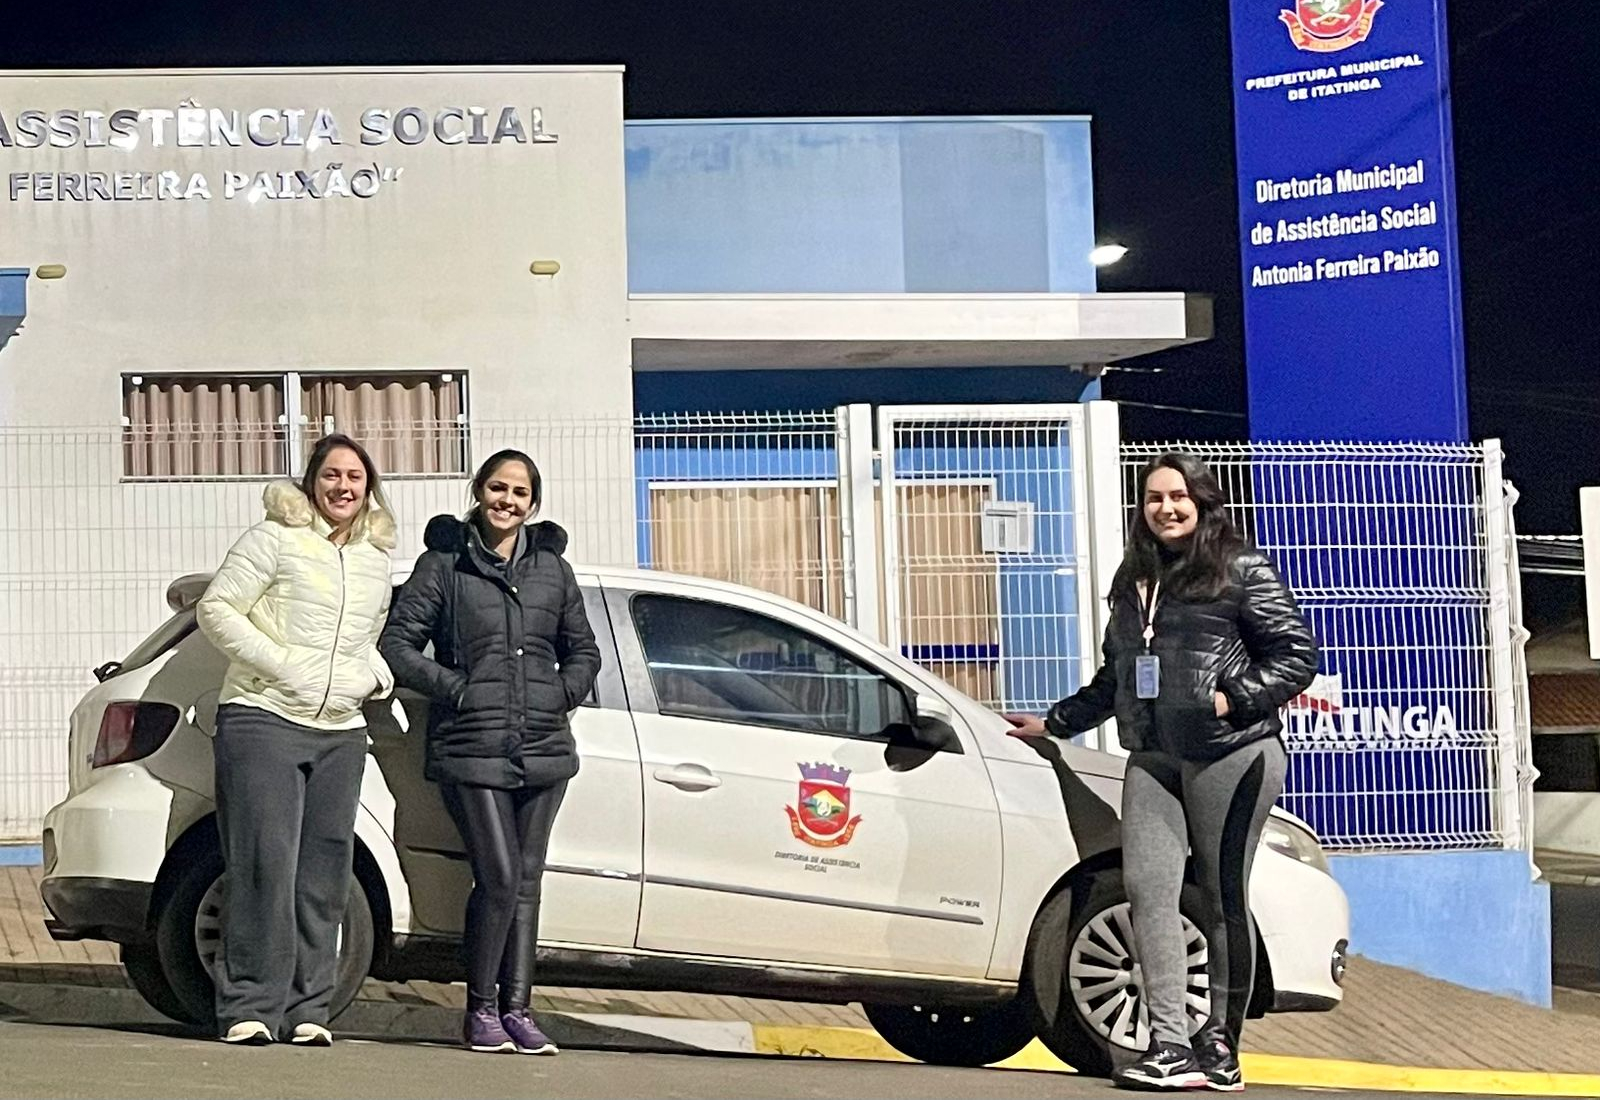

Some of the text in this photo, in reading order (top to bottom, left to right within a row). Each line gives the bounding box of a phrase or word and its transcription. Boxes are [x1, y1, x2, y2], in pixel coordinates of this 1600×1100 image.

[1246, 54, 1423, 90] PREFEITURA MUNICIPAL
[1288, 78, 1381, 101] DE ITATINGA
[360, 106, 559, 145] SOCIAL
[9, 170, 212, 201] FERREIRA
[1256, 160, 1423, 203] Diretoria Municipal
[1251, 201, 1436, 245] de Assistência Social
[1252, 246, 1439, 287] Antonia Ferreira Paixão
[939, 896, 980, 908] POWER
